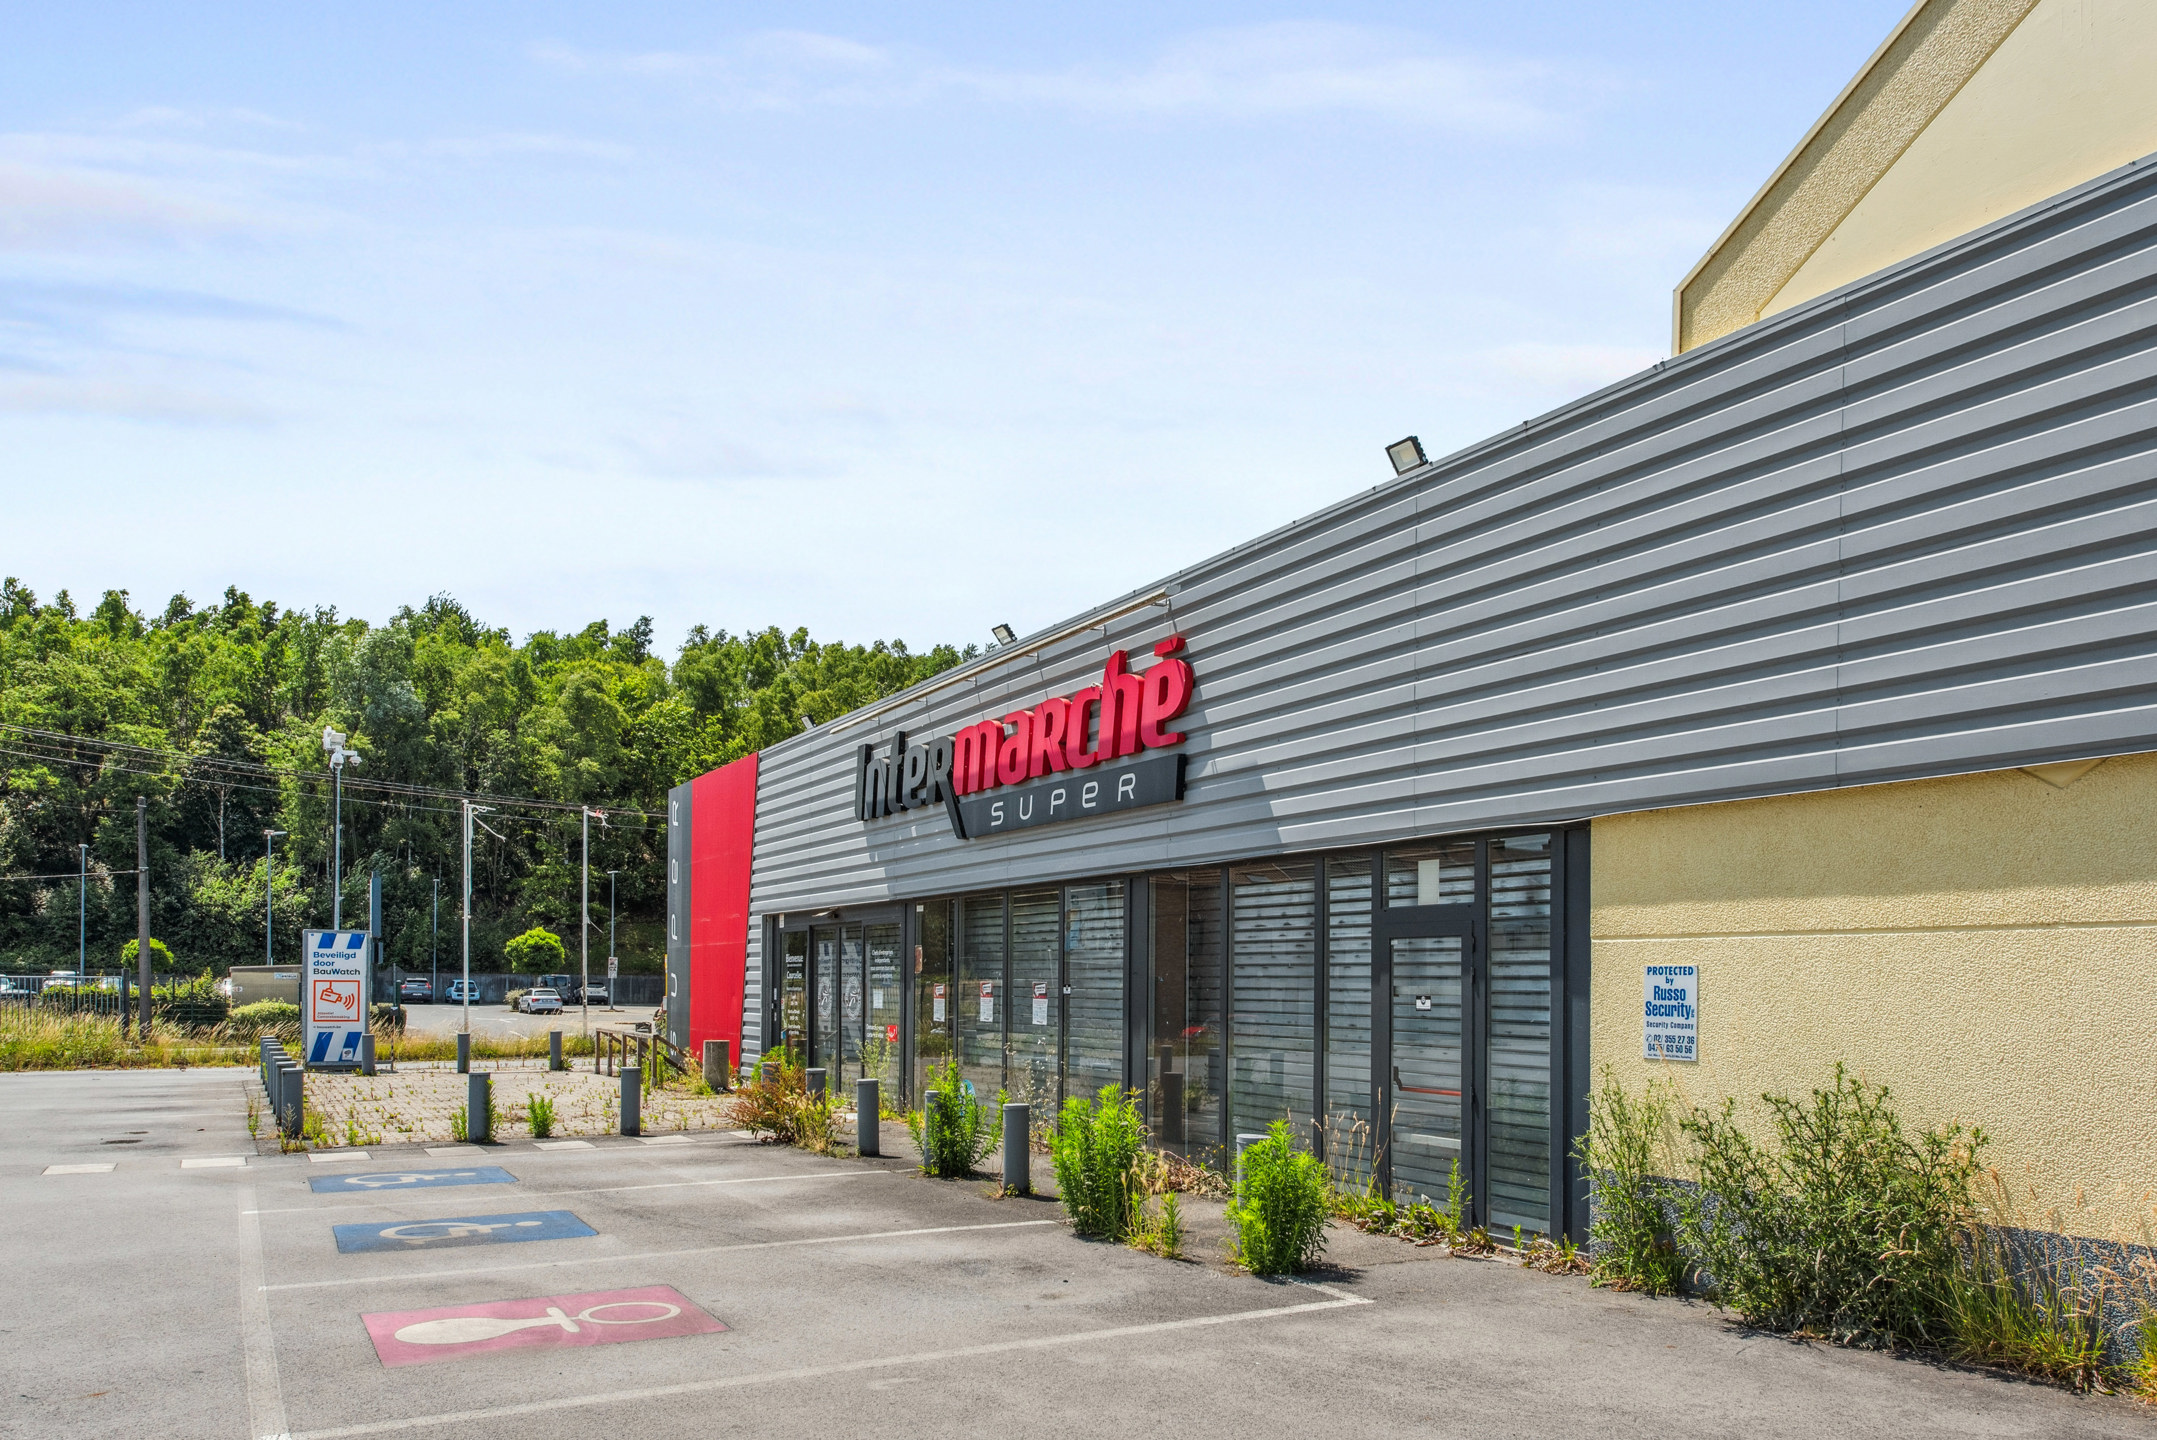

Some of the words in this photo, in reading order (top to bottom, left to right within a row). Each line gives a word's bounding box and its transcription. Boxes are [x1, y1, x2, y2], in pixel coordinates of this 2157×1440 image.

[313, 951, 356, 960] Beveiligd
[313, 959, 335, 967] door
[1647, 966, 1694, 976] PROTECTED
[1665, 976, 1674, 986] by
[1653, 985, 1686, 1001] Russo
[1645, 1001, 1691, 1020] Security
[1646, 1021, 1669, 1030] Security
[1670, 1021, 1694, 1031] Company
[1664, 1034, 1676, 1044] 355
[1677, 1035, 1686, 1044] 27
[1686, 1036, 1695, 1045] 36
[1666, 1044, 1674, 1053] 63
[1675, 1045, 1683, 1053] 50
[1684, 1045, 1693, 1054] 56
